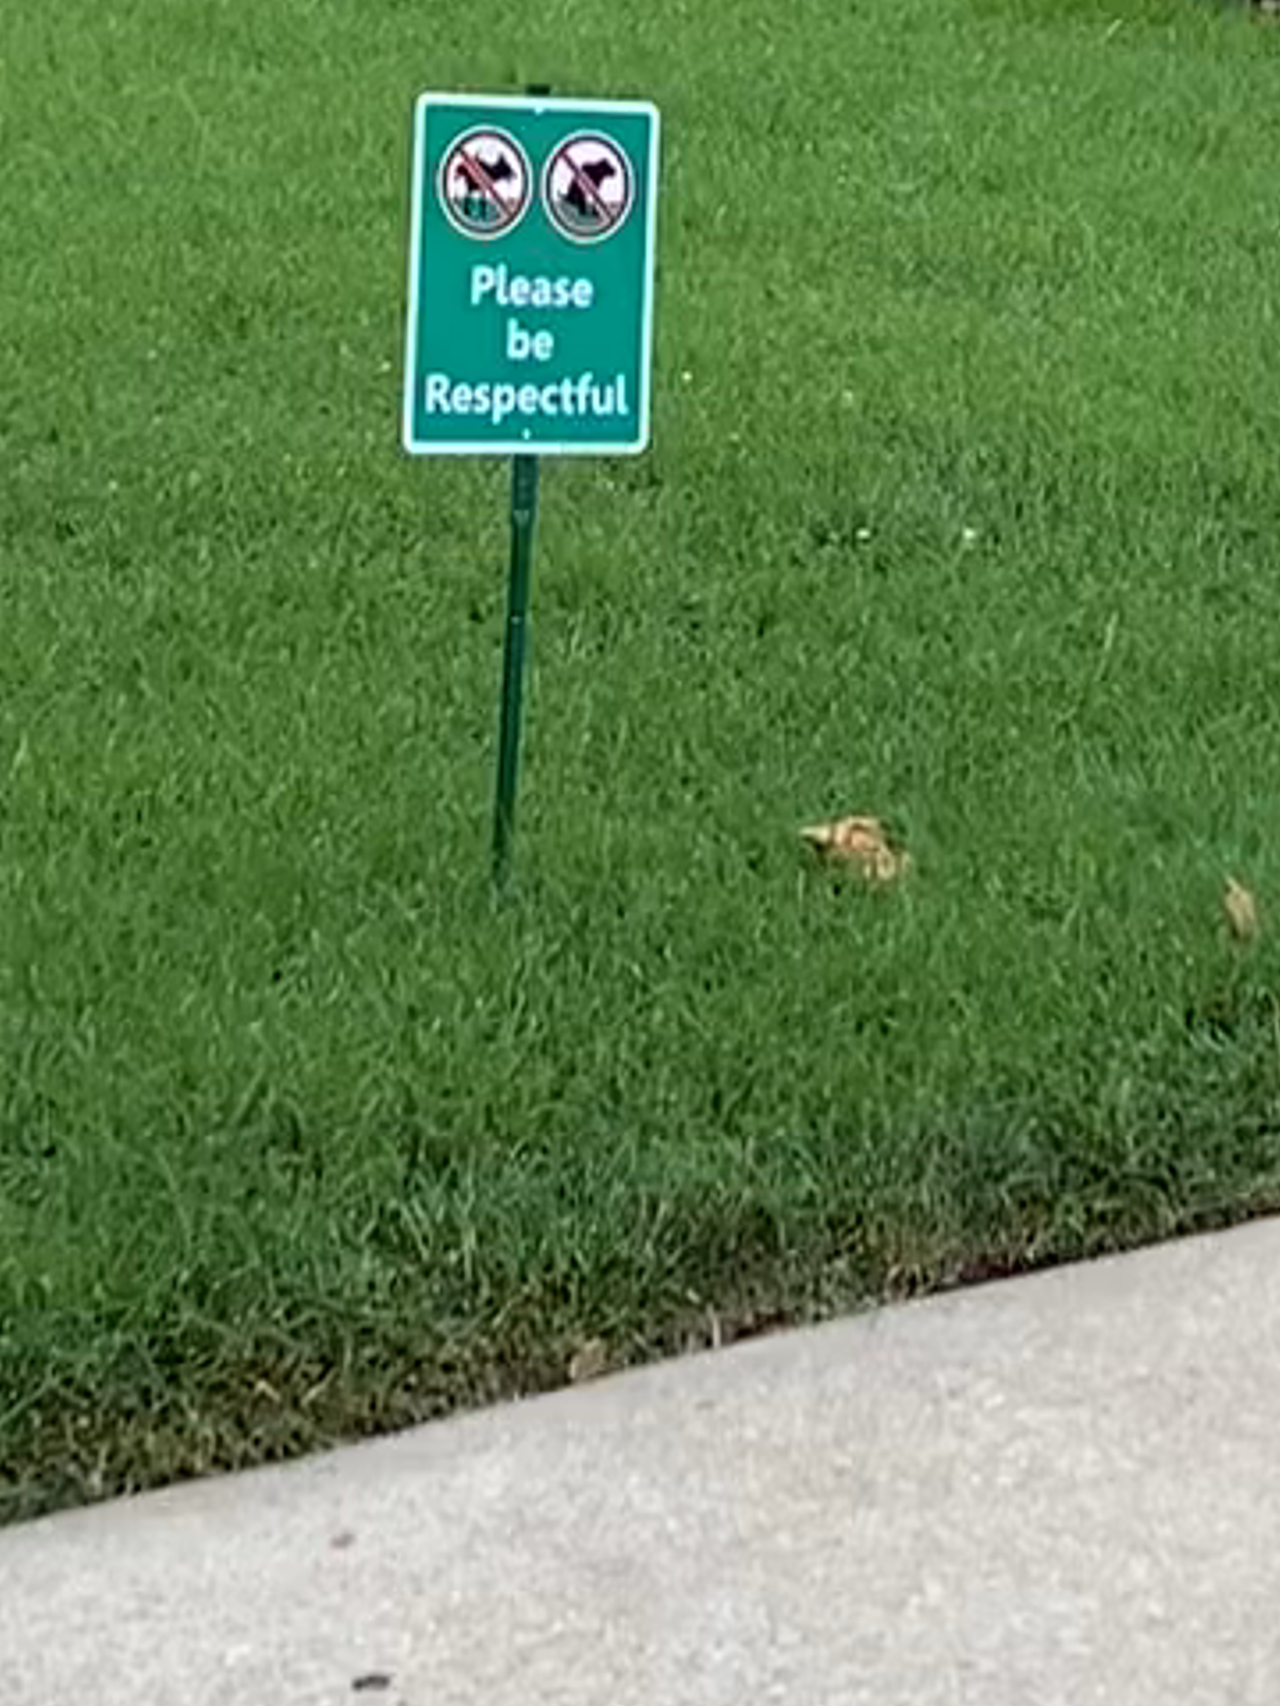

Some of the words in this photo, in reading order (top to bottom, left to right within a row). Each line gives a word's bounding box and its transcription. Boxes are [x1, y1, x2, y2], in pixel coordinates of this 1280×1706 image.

[470, 263, 594, 308] Please
[506, 317, 554, 360] be
[425, 371, 629, 425] Respectful
